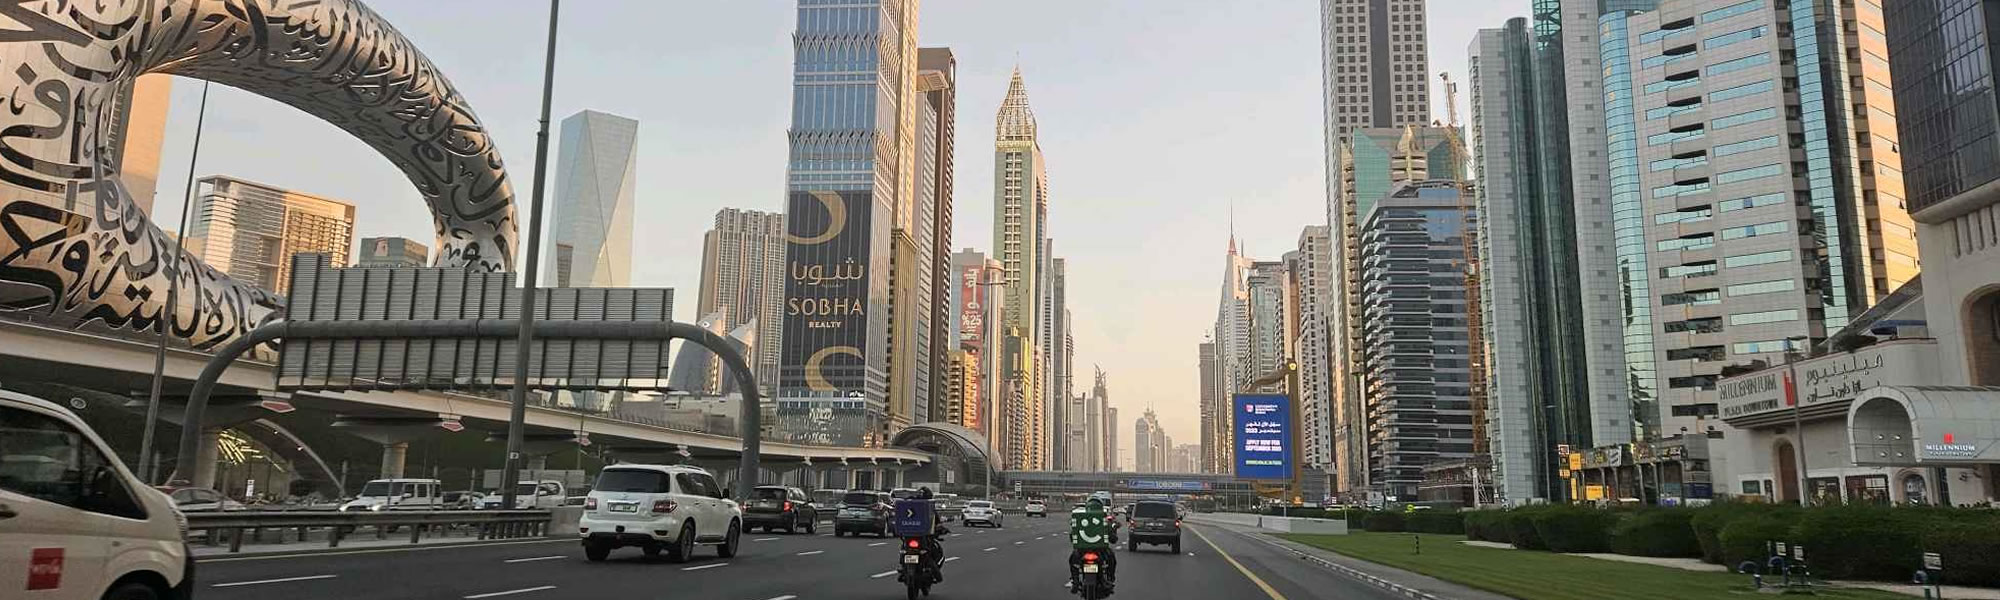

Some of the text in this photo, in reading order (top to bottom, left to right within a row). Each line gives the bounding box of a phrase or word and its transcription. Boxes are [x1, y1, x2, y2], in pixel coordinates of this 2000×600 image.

[791, 257, 864, 285] شوبا
[788, 298, 864, 316] SOBHA
[1806, 353, 1884, 386] ميلينيوم
[1718, 374, 1777, 400] MILLENNIUM
